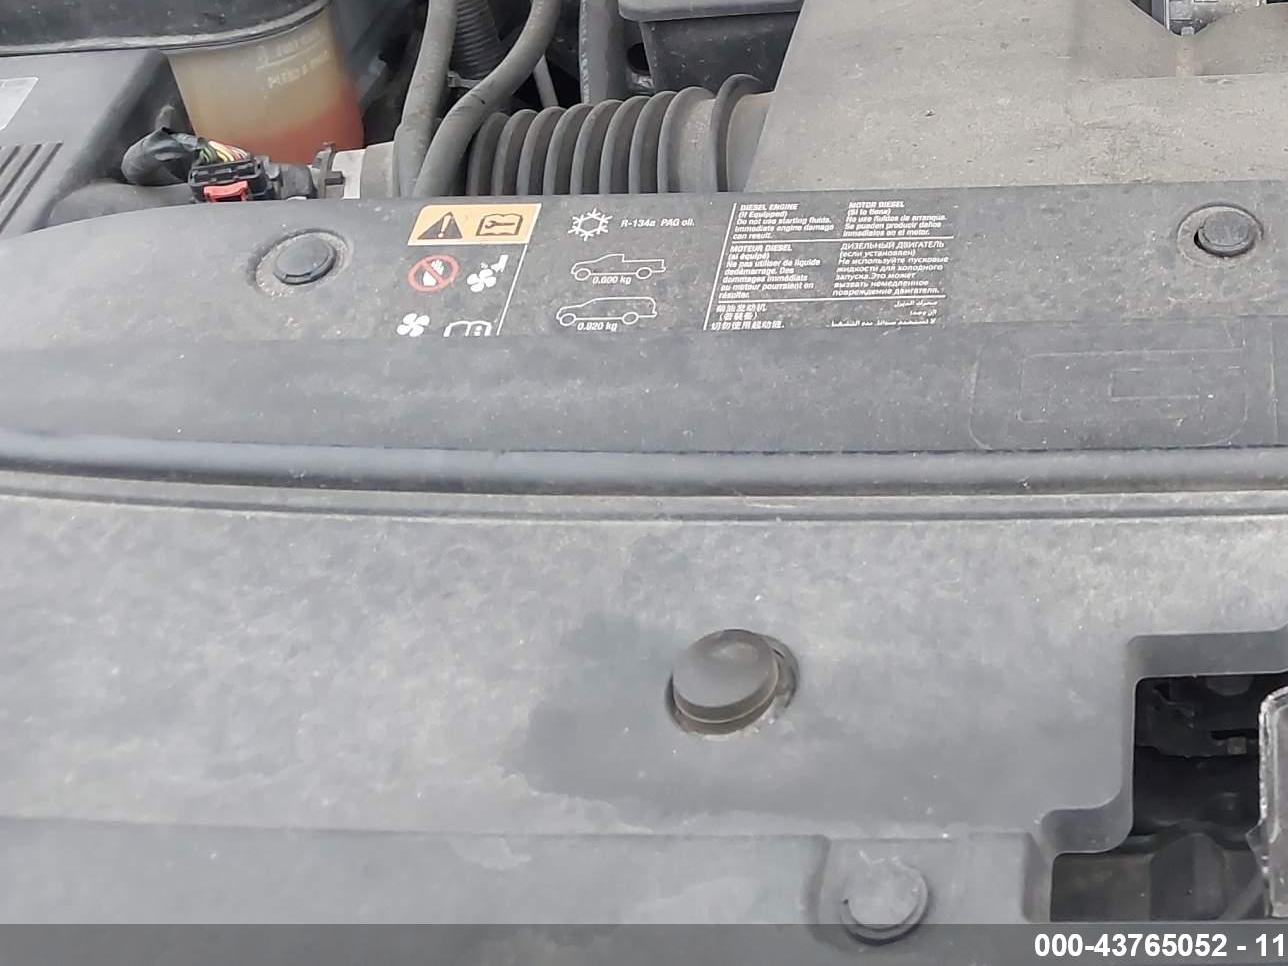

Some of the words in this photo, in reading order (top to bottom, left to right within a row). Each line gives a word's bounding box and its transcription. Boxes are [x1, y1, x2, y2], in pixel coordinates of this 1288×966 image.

[660, 219, 680, 227] PAG
[840, 242, 895, 250] ДИЗЕЛЬНЫЙ
[896, 241, 944, 249] ДВИГАТЕЛЬ
[620, 275, 631, 284] kg
[605, 322, 618, 331] kg
